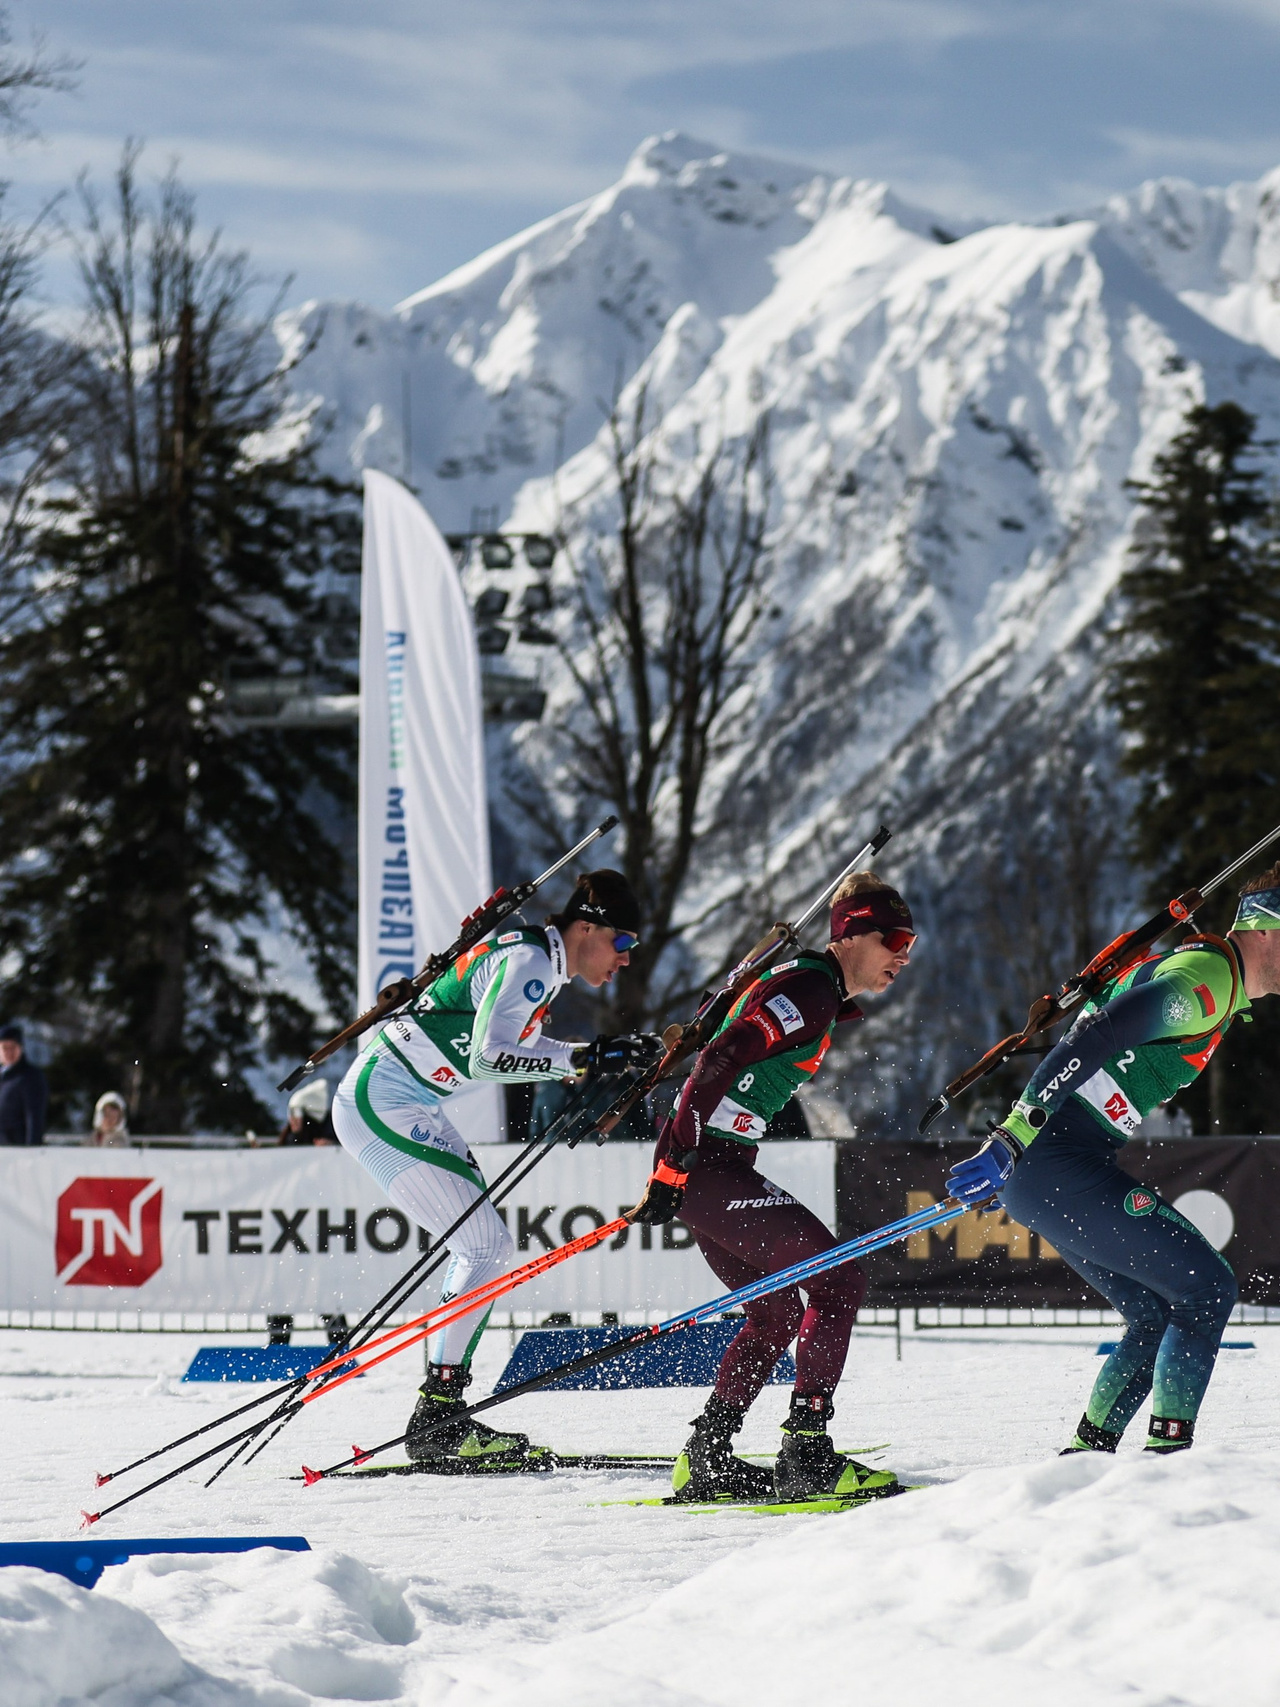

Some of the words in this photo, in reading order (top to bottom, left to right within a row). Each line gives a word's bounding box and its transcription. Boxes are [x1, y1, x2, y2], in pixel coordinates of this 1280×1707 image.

[1116, 1050, 1136, 1074] 2
[738, 1072, 755, 1093] 8
[1038, 1057, 1082, 1103] ORAZ
[183, 1207, 699, 1255] ТЕХНОКОЛЬ
